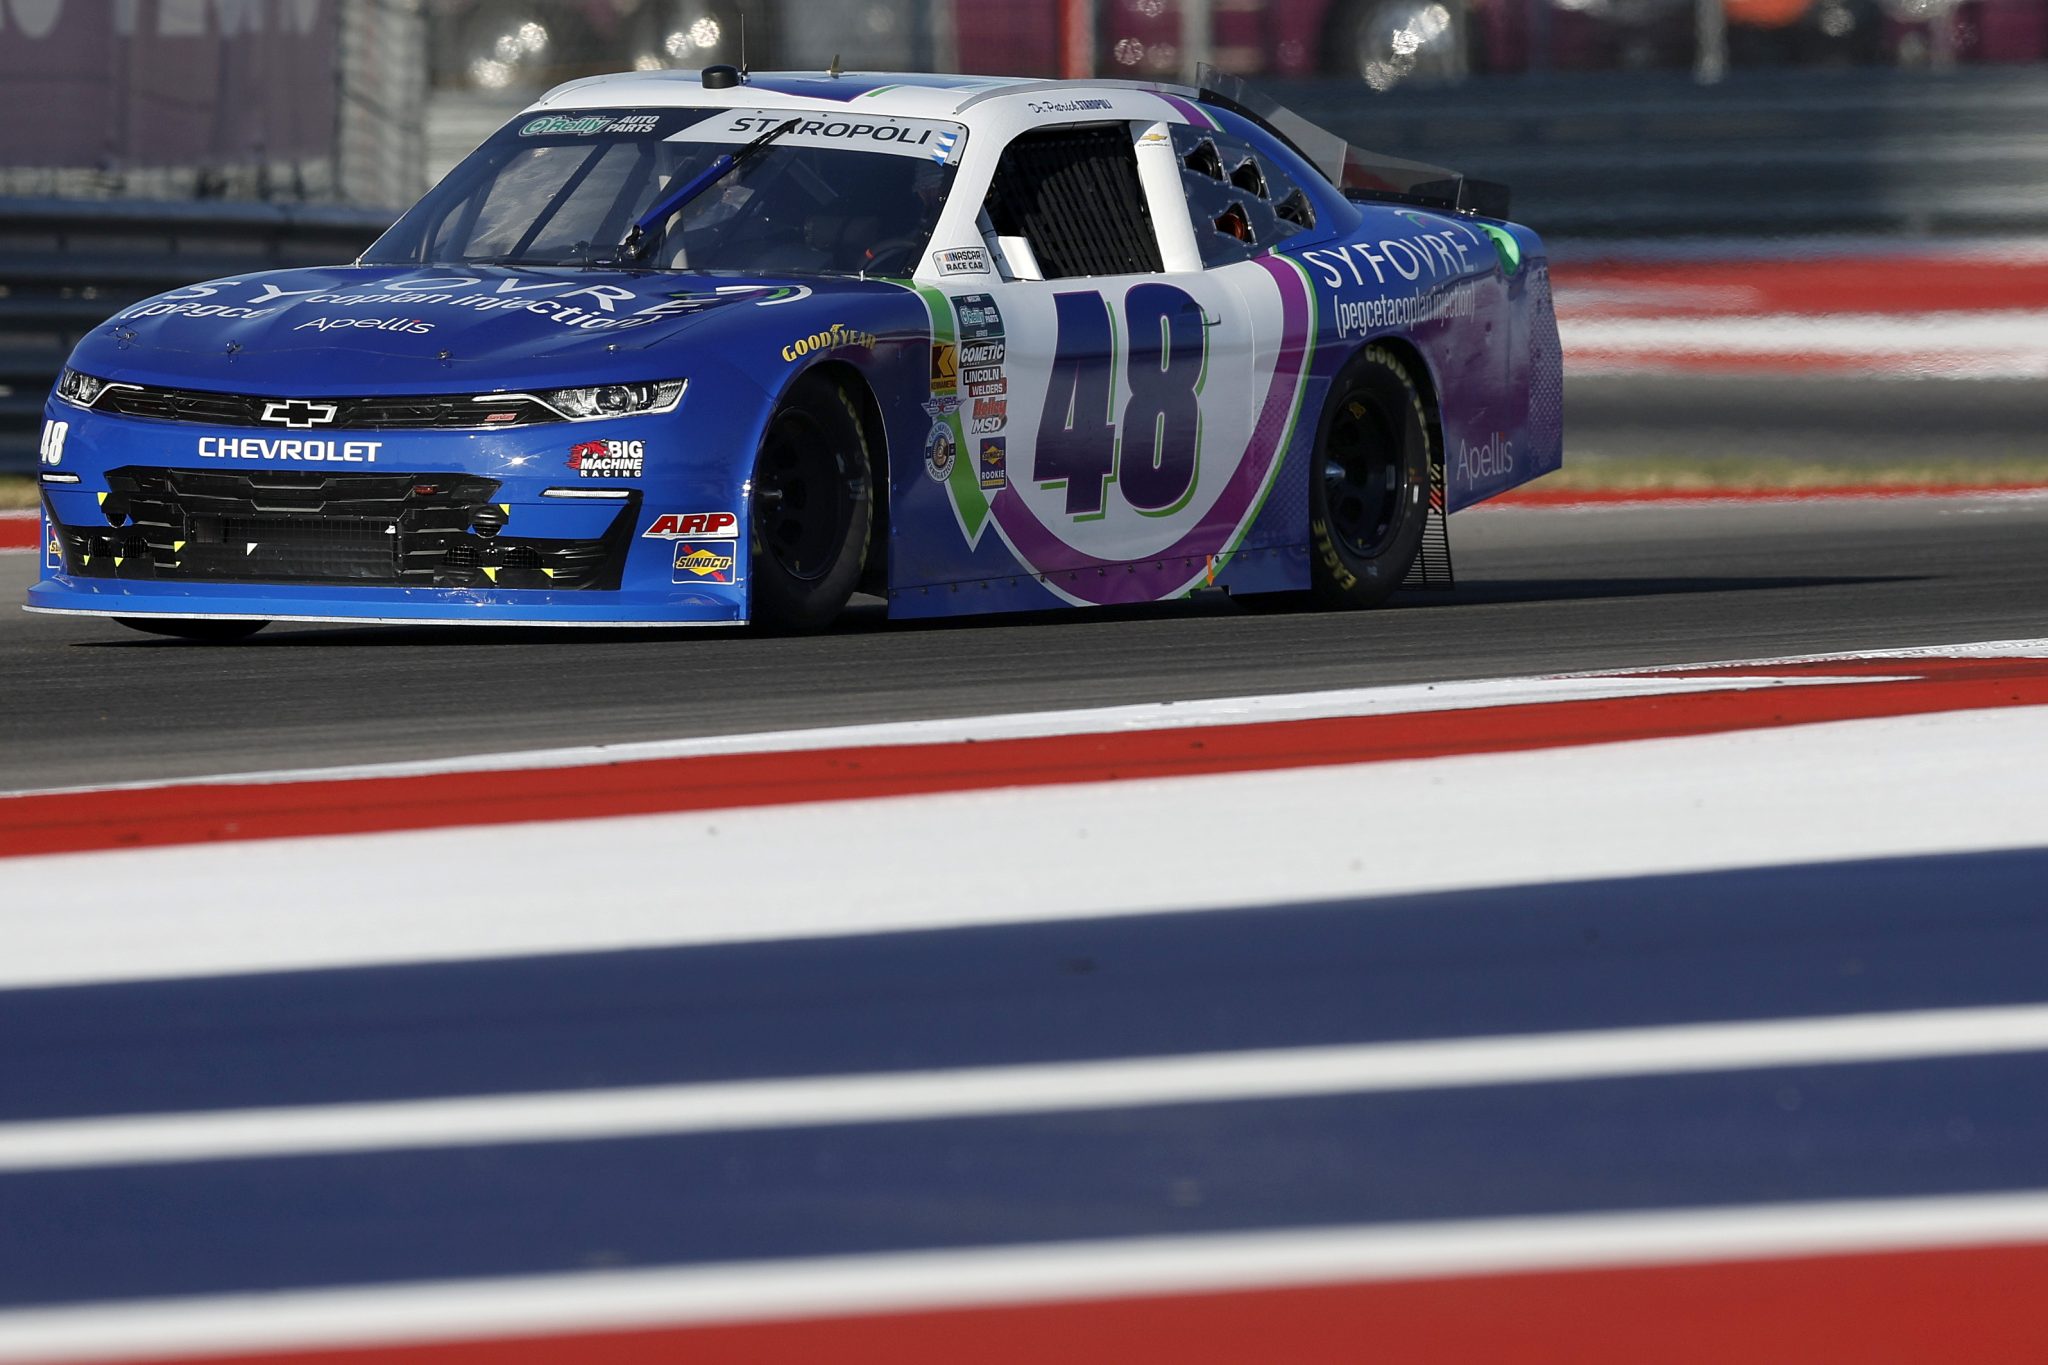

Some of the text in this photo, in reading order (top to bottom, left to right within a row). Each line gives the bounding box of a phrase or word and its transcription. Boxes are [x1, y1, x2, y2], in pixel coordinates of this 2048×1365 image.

[1043, 100, 1078, 112] Patrick
[520, 115, 660, 137] O'Reilly AUTO
[605, 124, 656, 133] PARTS
[951, 250, 982, 262] NASCAR
[1302, 230, 1474, 288] SYFOVRE
[946, 261, 984, 271] RACE CAR
[163, 277, 721, 316] SYOVRE
[293, 316, 437, 335] Apellis
[782, 323, 877, 362] GOODYEAR
[961, 344, 1004, 363] COMETIC
[964, 368, 1000, 384] LINCOLN
[972, 383, 1003, 396] WELDERS
[1033, 282, 1208, 520] 48
[971, 417, 1002, 434] MSD
[40, 419, 69, 466] 48
[198, 437, 383, 463] CHEVROLET
[608, 440, 644, 458] BIG
[580, 458, 644, 470] MACHINE
[1456, 431, 1514, 490] Apellis
[580, 470, 643, 478] RACING
[981, 469, 1005, 480] ROOKIE
[648, 513, 735, 534] ARP
[677, 557, 730, 568] SUNOCO
